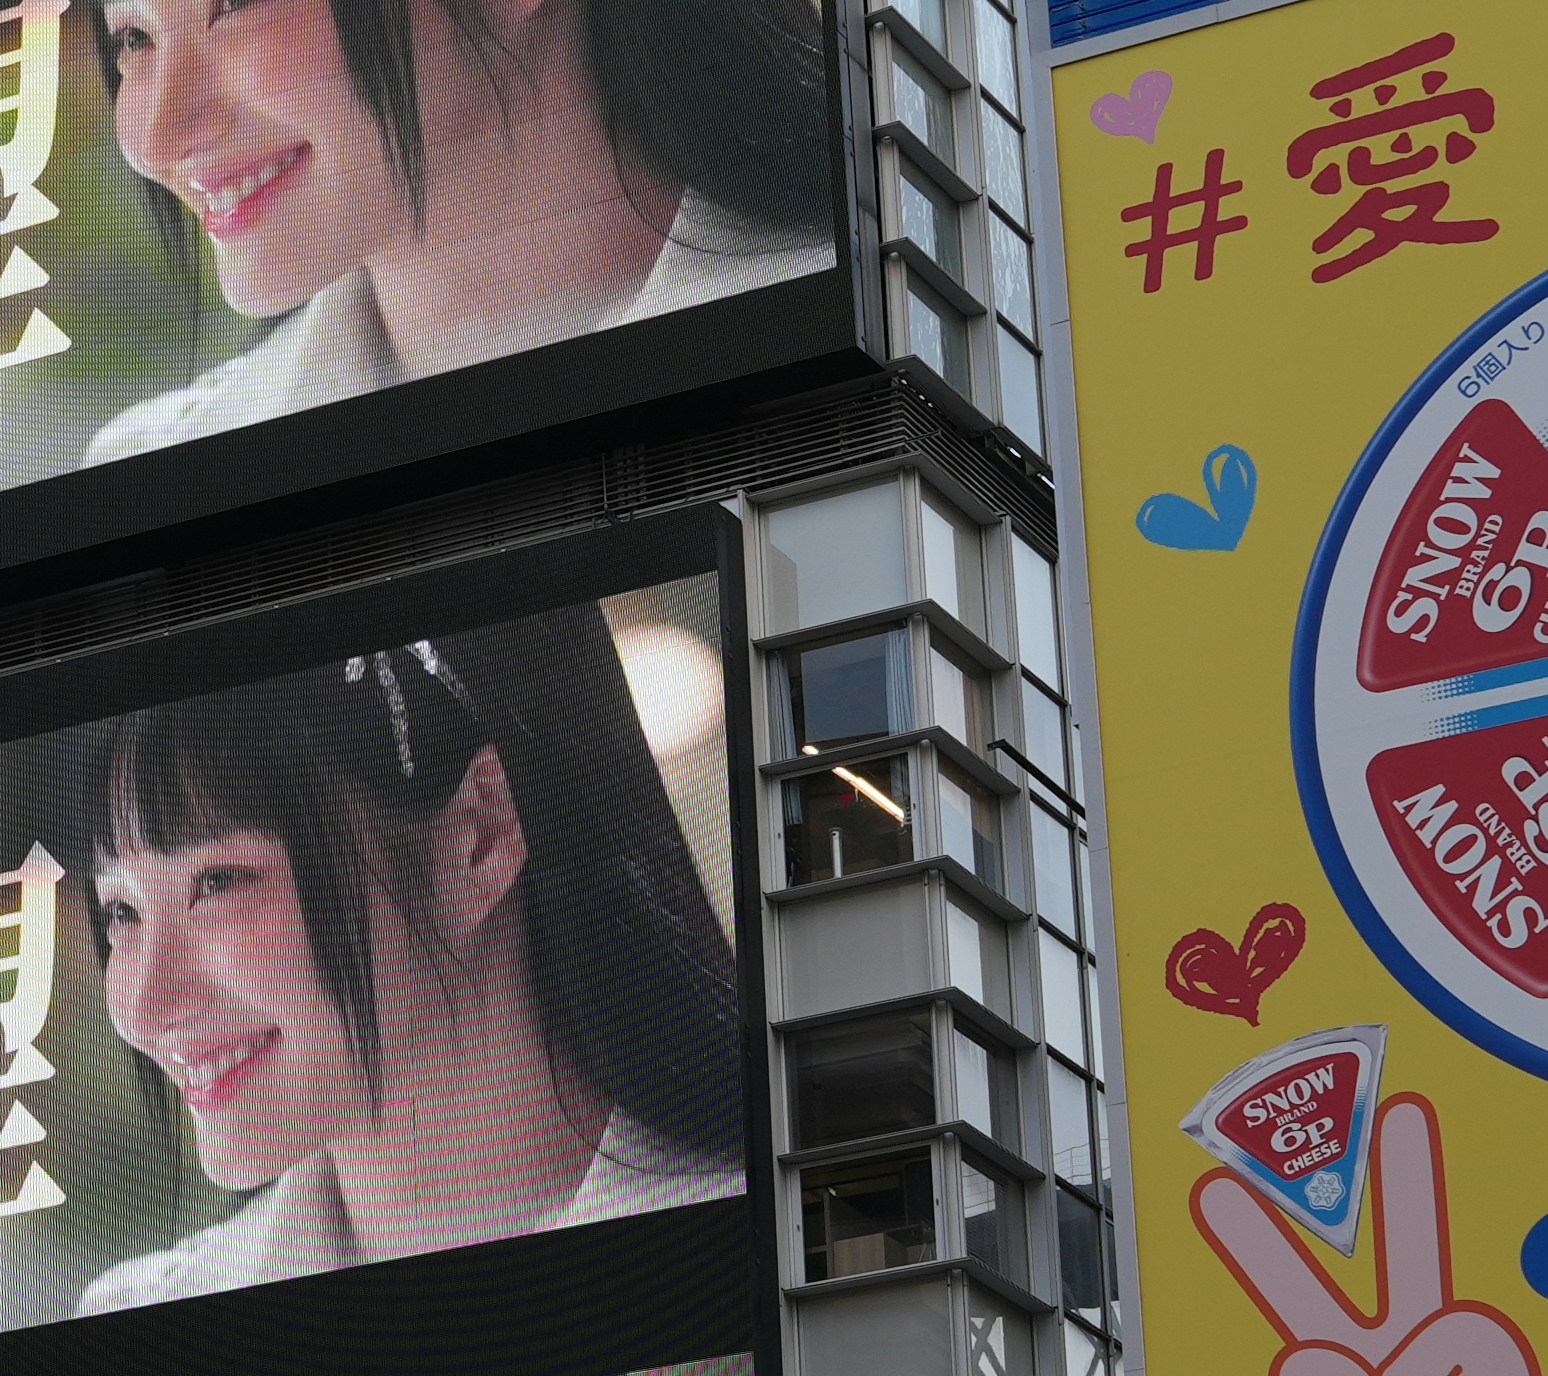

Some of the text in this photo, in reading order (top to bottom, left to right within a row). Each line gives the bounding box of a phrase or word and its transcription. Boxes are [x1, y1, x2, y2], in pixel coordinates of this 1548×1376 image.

[1456, 319, 1546, 399] 6個入り
[1386, 442, 1501, 643] SNOW
[1454, 515, 1503, 598] BRAND
[1475, 802, 1537, 876] BRAND
[1242, 1063, 1334, 1128] SNOW
[1275, 1101, 1317, 1127] BRAND
[1283, 1139, 1341, 1175] CHEESE
